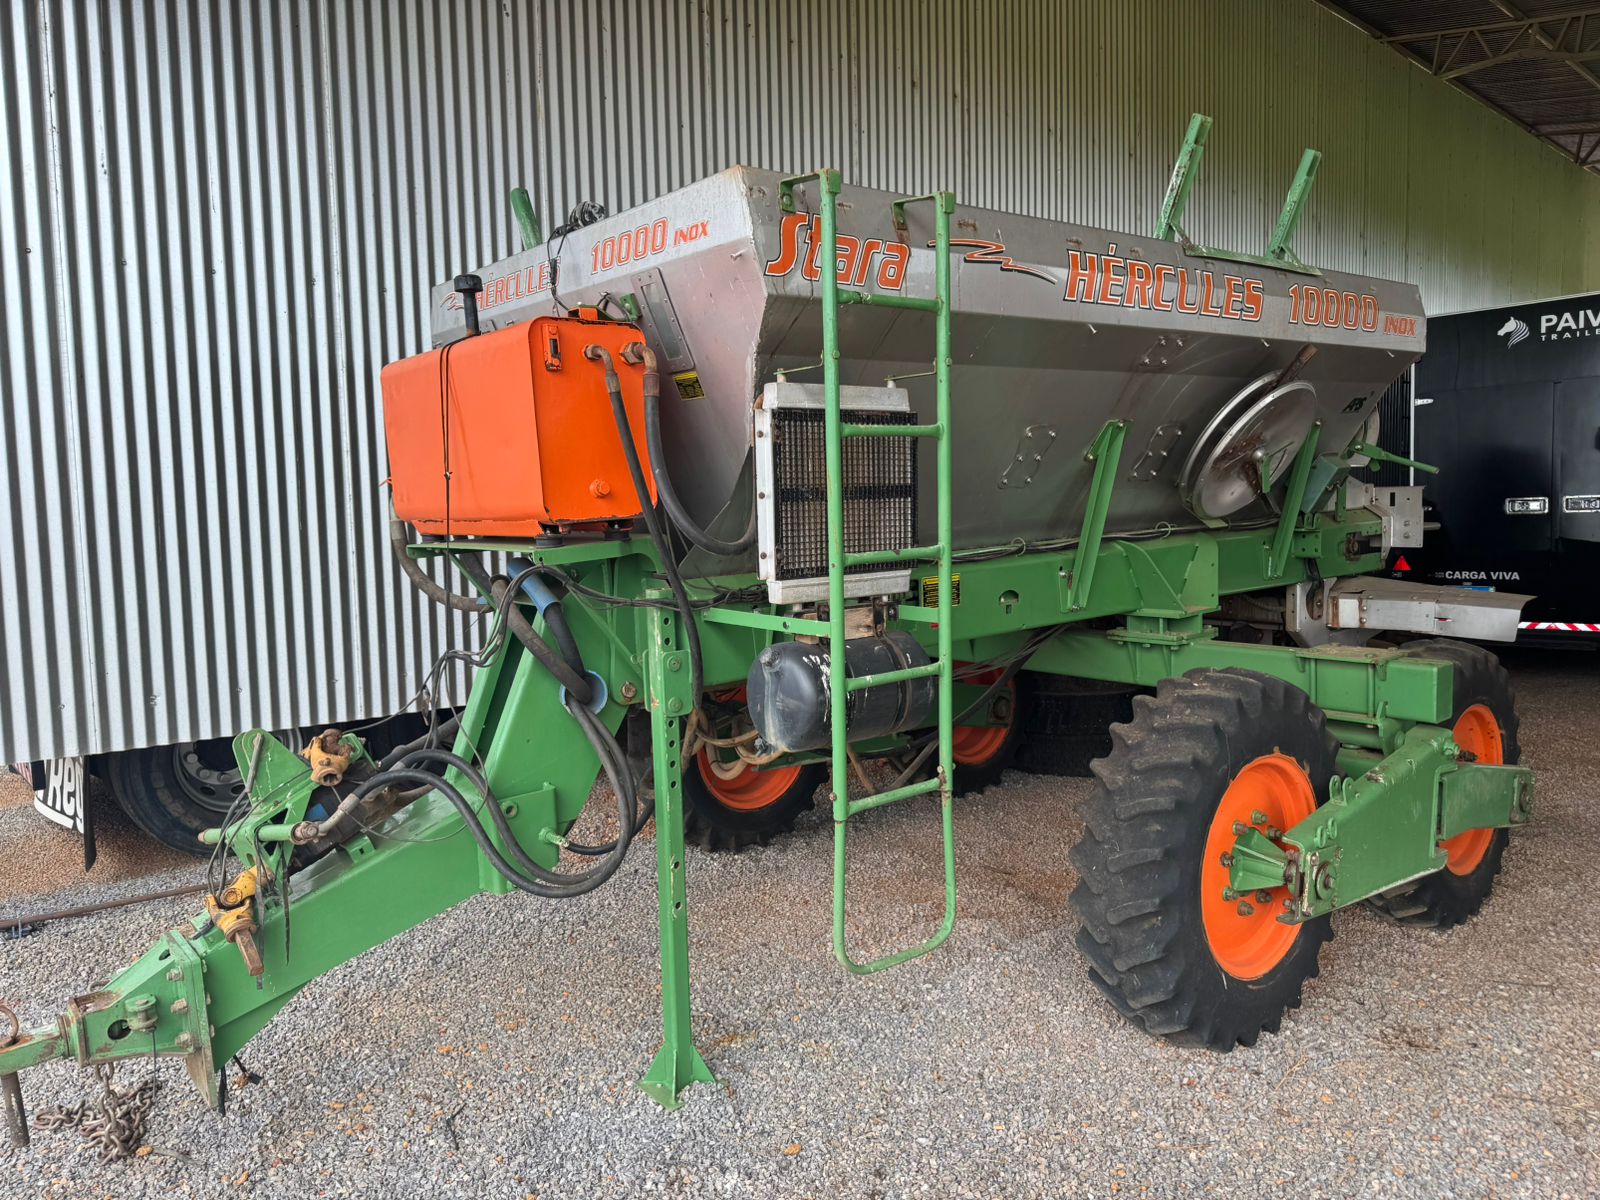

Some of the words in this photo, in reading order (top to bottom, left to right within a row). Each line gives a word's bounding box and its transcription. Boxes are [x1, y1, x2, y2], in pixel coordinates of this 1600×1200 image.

[591, 216, 669, 275] 10000
[672, 219, 710, 247] INOX
[764, 211, 911, 291] Stara
[1063, 242, 1265, 322] HÉRCULES
[1288, 283, 1379, 333] 10000
[1383, 313, 1417, 338] INOX
[1445, 571, 1487, 580] CARGA
[1491, 571, 1520, 580] VIVA
